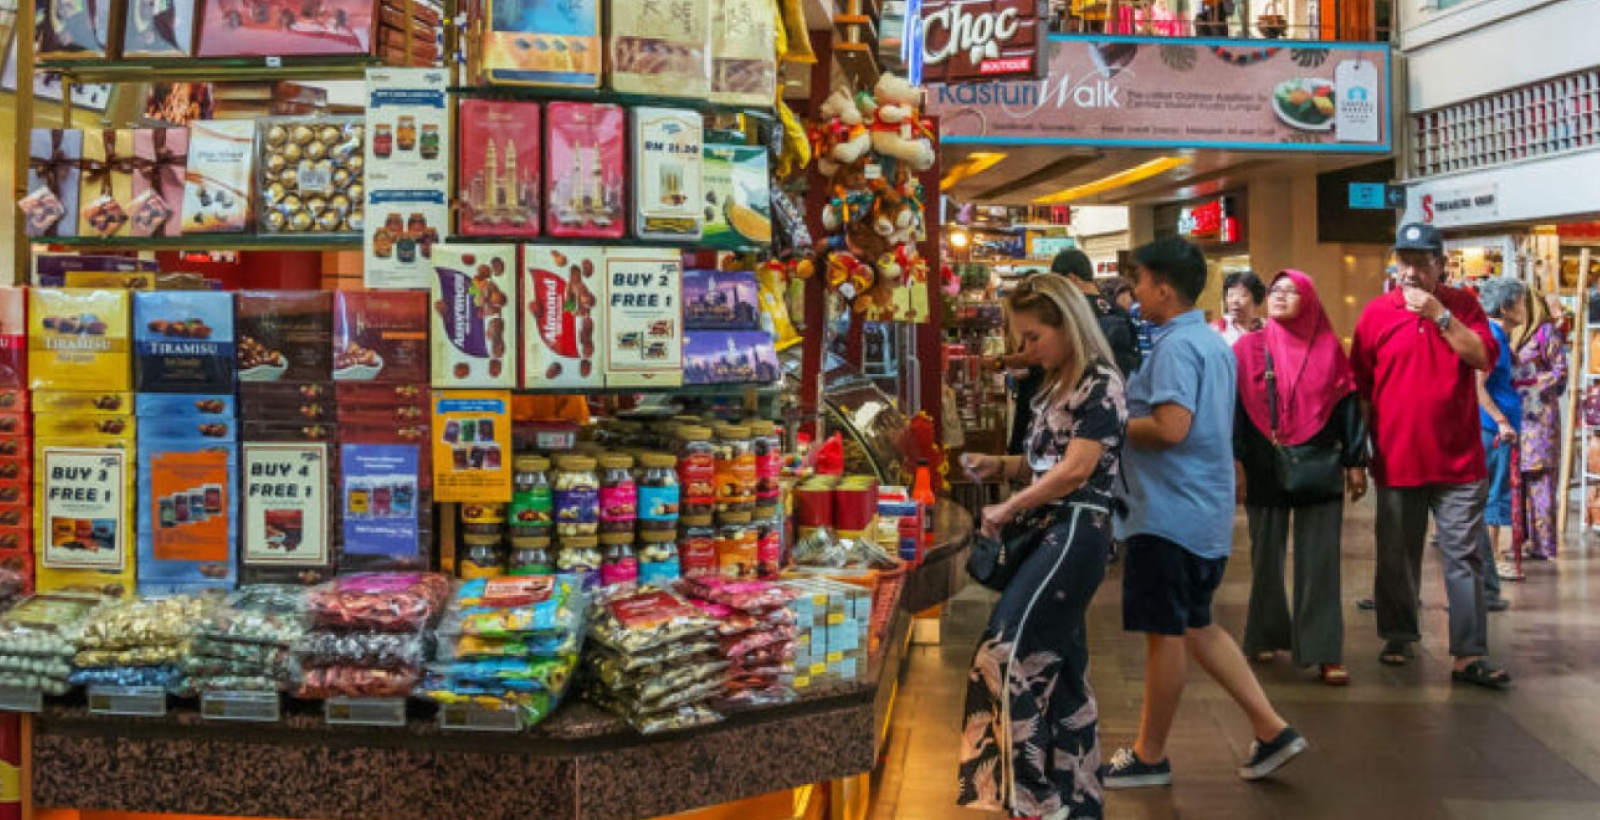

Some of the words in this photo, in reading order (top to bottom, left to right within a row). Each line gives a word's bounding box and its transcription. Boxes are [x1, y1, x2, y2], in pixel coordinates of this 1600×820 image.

[922, 4, 1018, 64] Choc
[981, 59, 1030, 72] BOUTIQUE
[612, 272, 653, 287] BUY
[658, 275, 669, 287] 2
[610, 293, 658, 308] FREE
[666, 295, 672, 308] 1
[543, 278, 556, 345] Almond
[150, 342, 218, 355] TIRAMISU
[51, 466, 92, 481] BUY
[251, 462, 291, 477] BUY
[298, 465, 309, 477] 4
[49, 487, 98, 502] FREE
[104, 490, 111, 503] 1
[249, 482, 299, 498] FREE
[305, 485, 312, 498] 1
